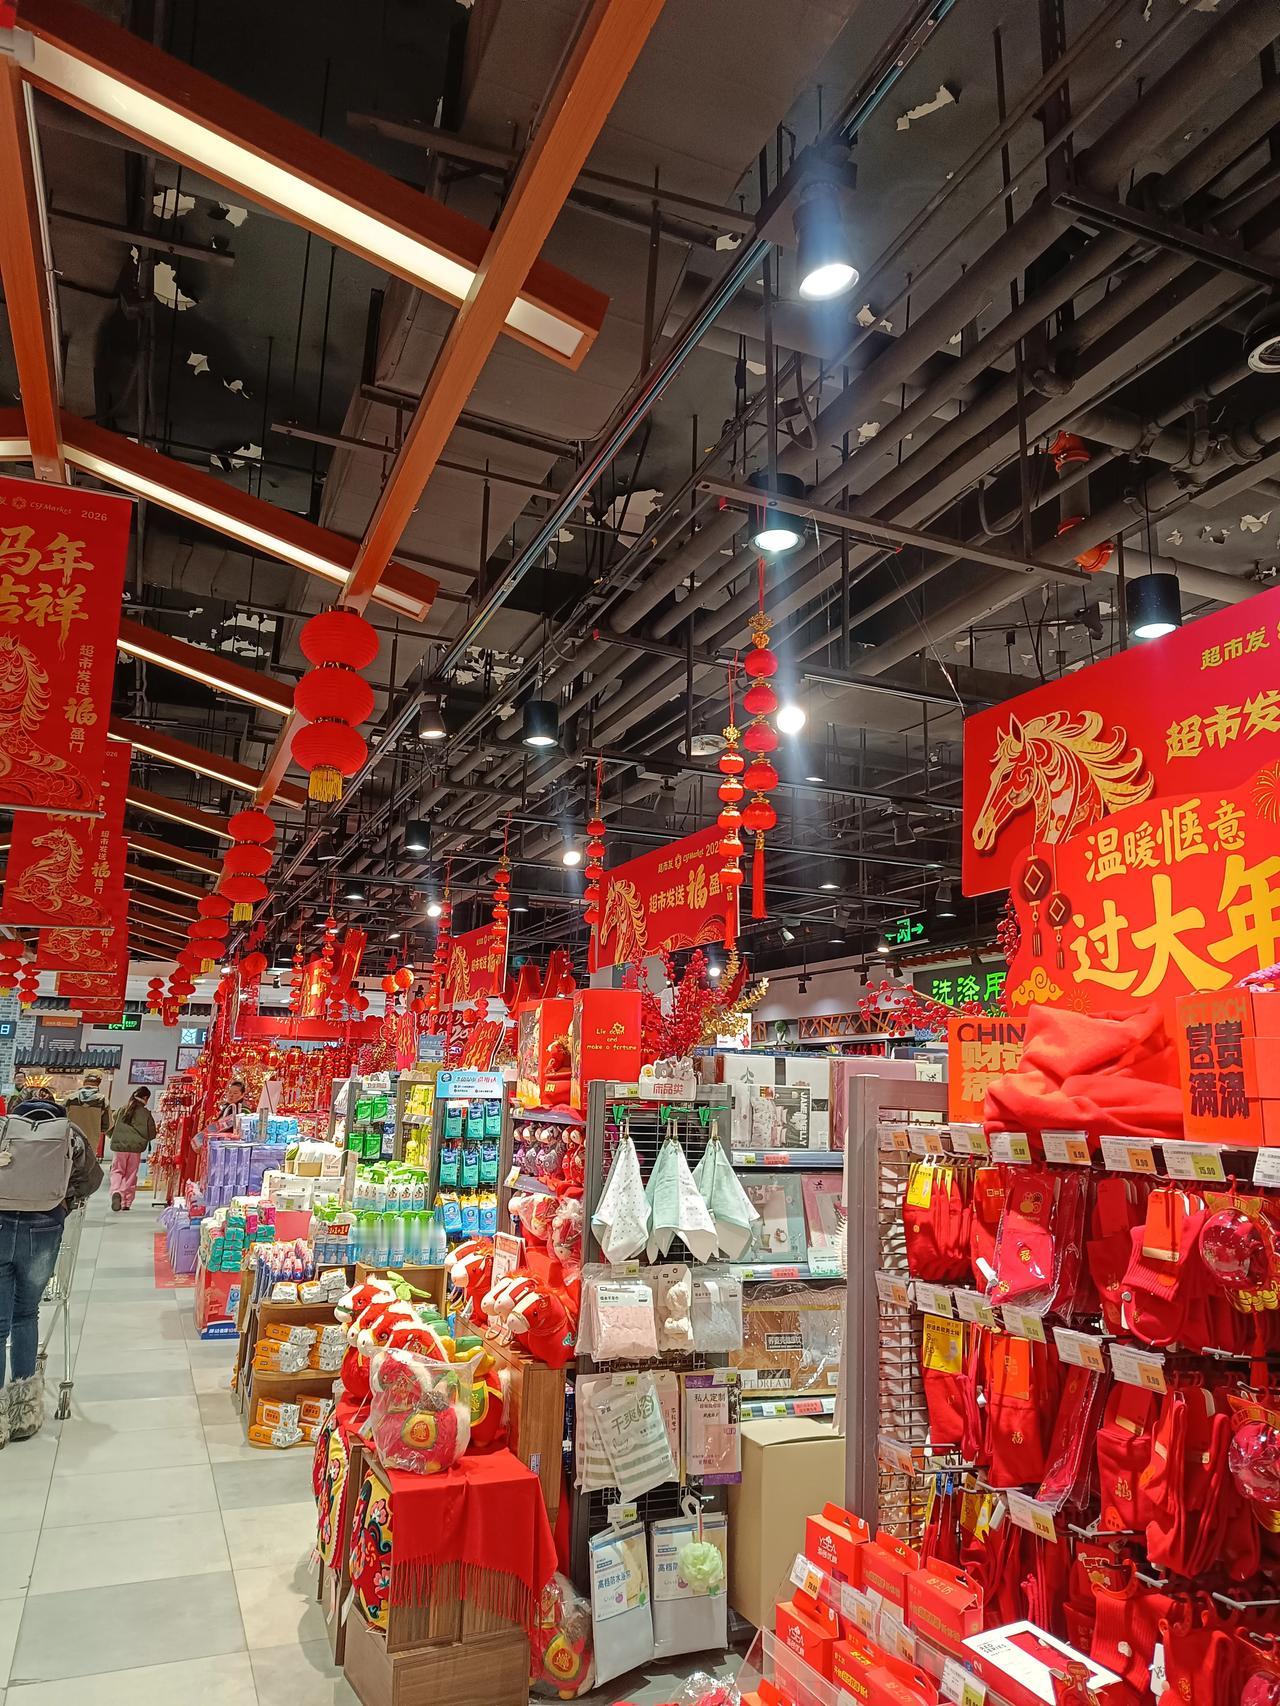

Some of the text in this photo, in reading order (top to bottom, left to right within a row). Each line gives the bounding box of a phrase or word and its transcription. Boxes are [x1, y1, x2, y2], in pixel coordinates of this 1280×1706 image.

[81, 510, 107, 521] 2026
[0, 526, 95, 585] 马年
[0, 573, 89, 662] 吉祥
[1200, 626, 1270, 670] 超市发
[63, 645, 98, 753] 超市发送福盈门
[1165, 690, 1280, 765] 超市发
[705, 840, 722, 857] 202
[1085, 798, 1246, 882] 温暖惬意
[649, 864, 723, 914] 超市发送福盈
[1070, 854, 1280, 997] 过大年
[1189, 1072, 1250, 1119] 满满
[757, 1379, 790, 1389] DREAM
